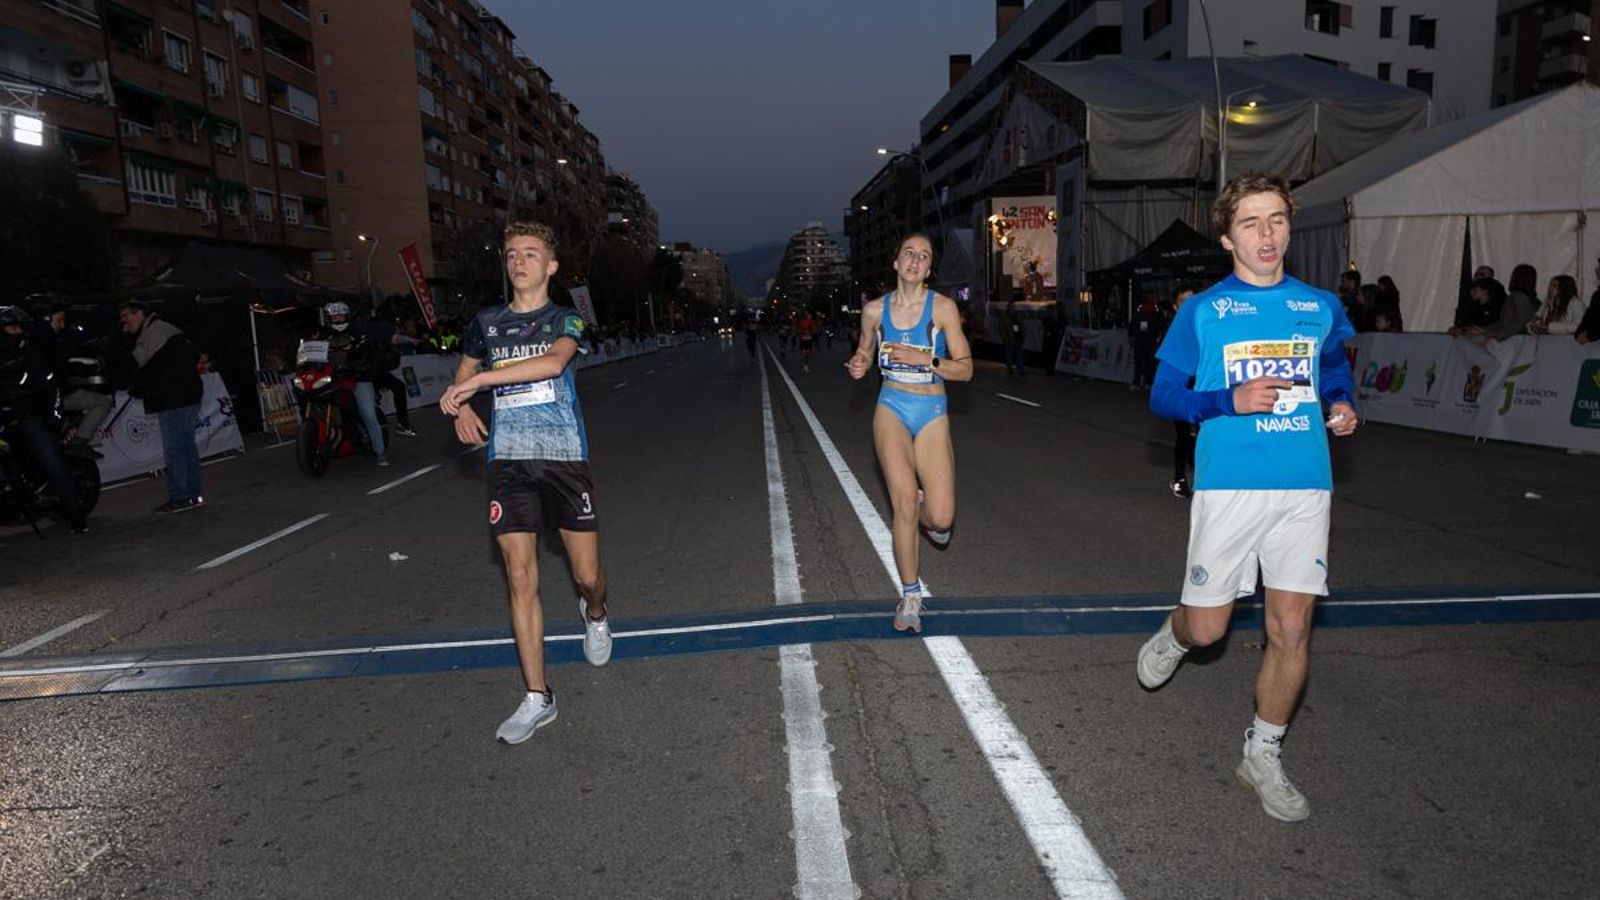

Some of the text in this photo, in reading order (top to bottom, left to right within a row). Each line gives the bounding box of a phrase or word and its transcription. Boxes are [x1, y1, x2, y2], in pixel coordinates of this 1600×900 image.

[1019, 206, 1045, 218] SAN
[511, 341, 553, 358] ANTÓ
[1229, 358, 1312, 382] 10234
[581, 491, 592, 514] 3
